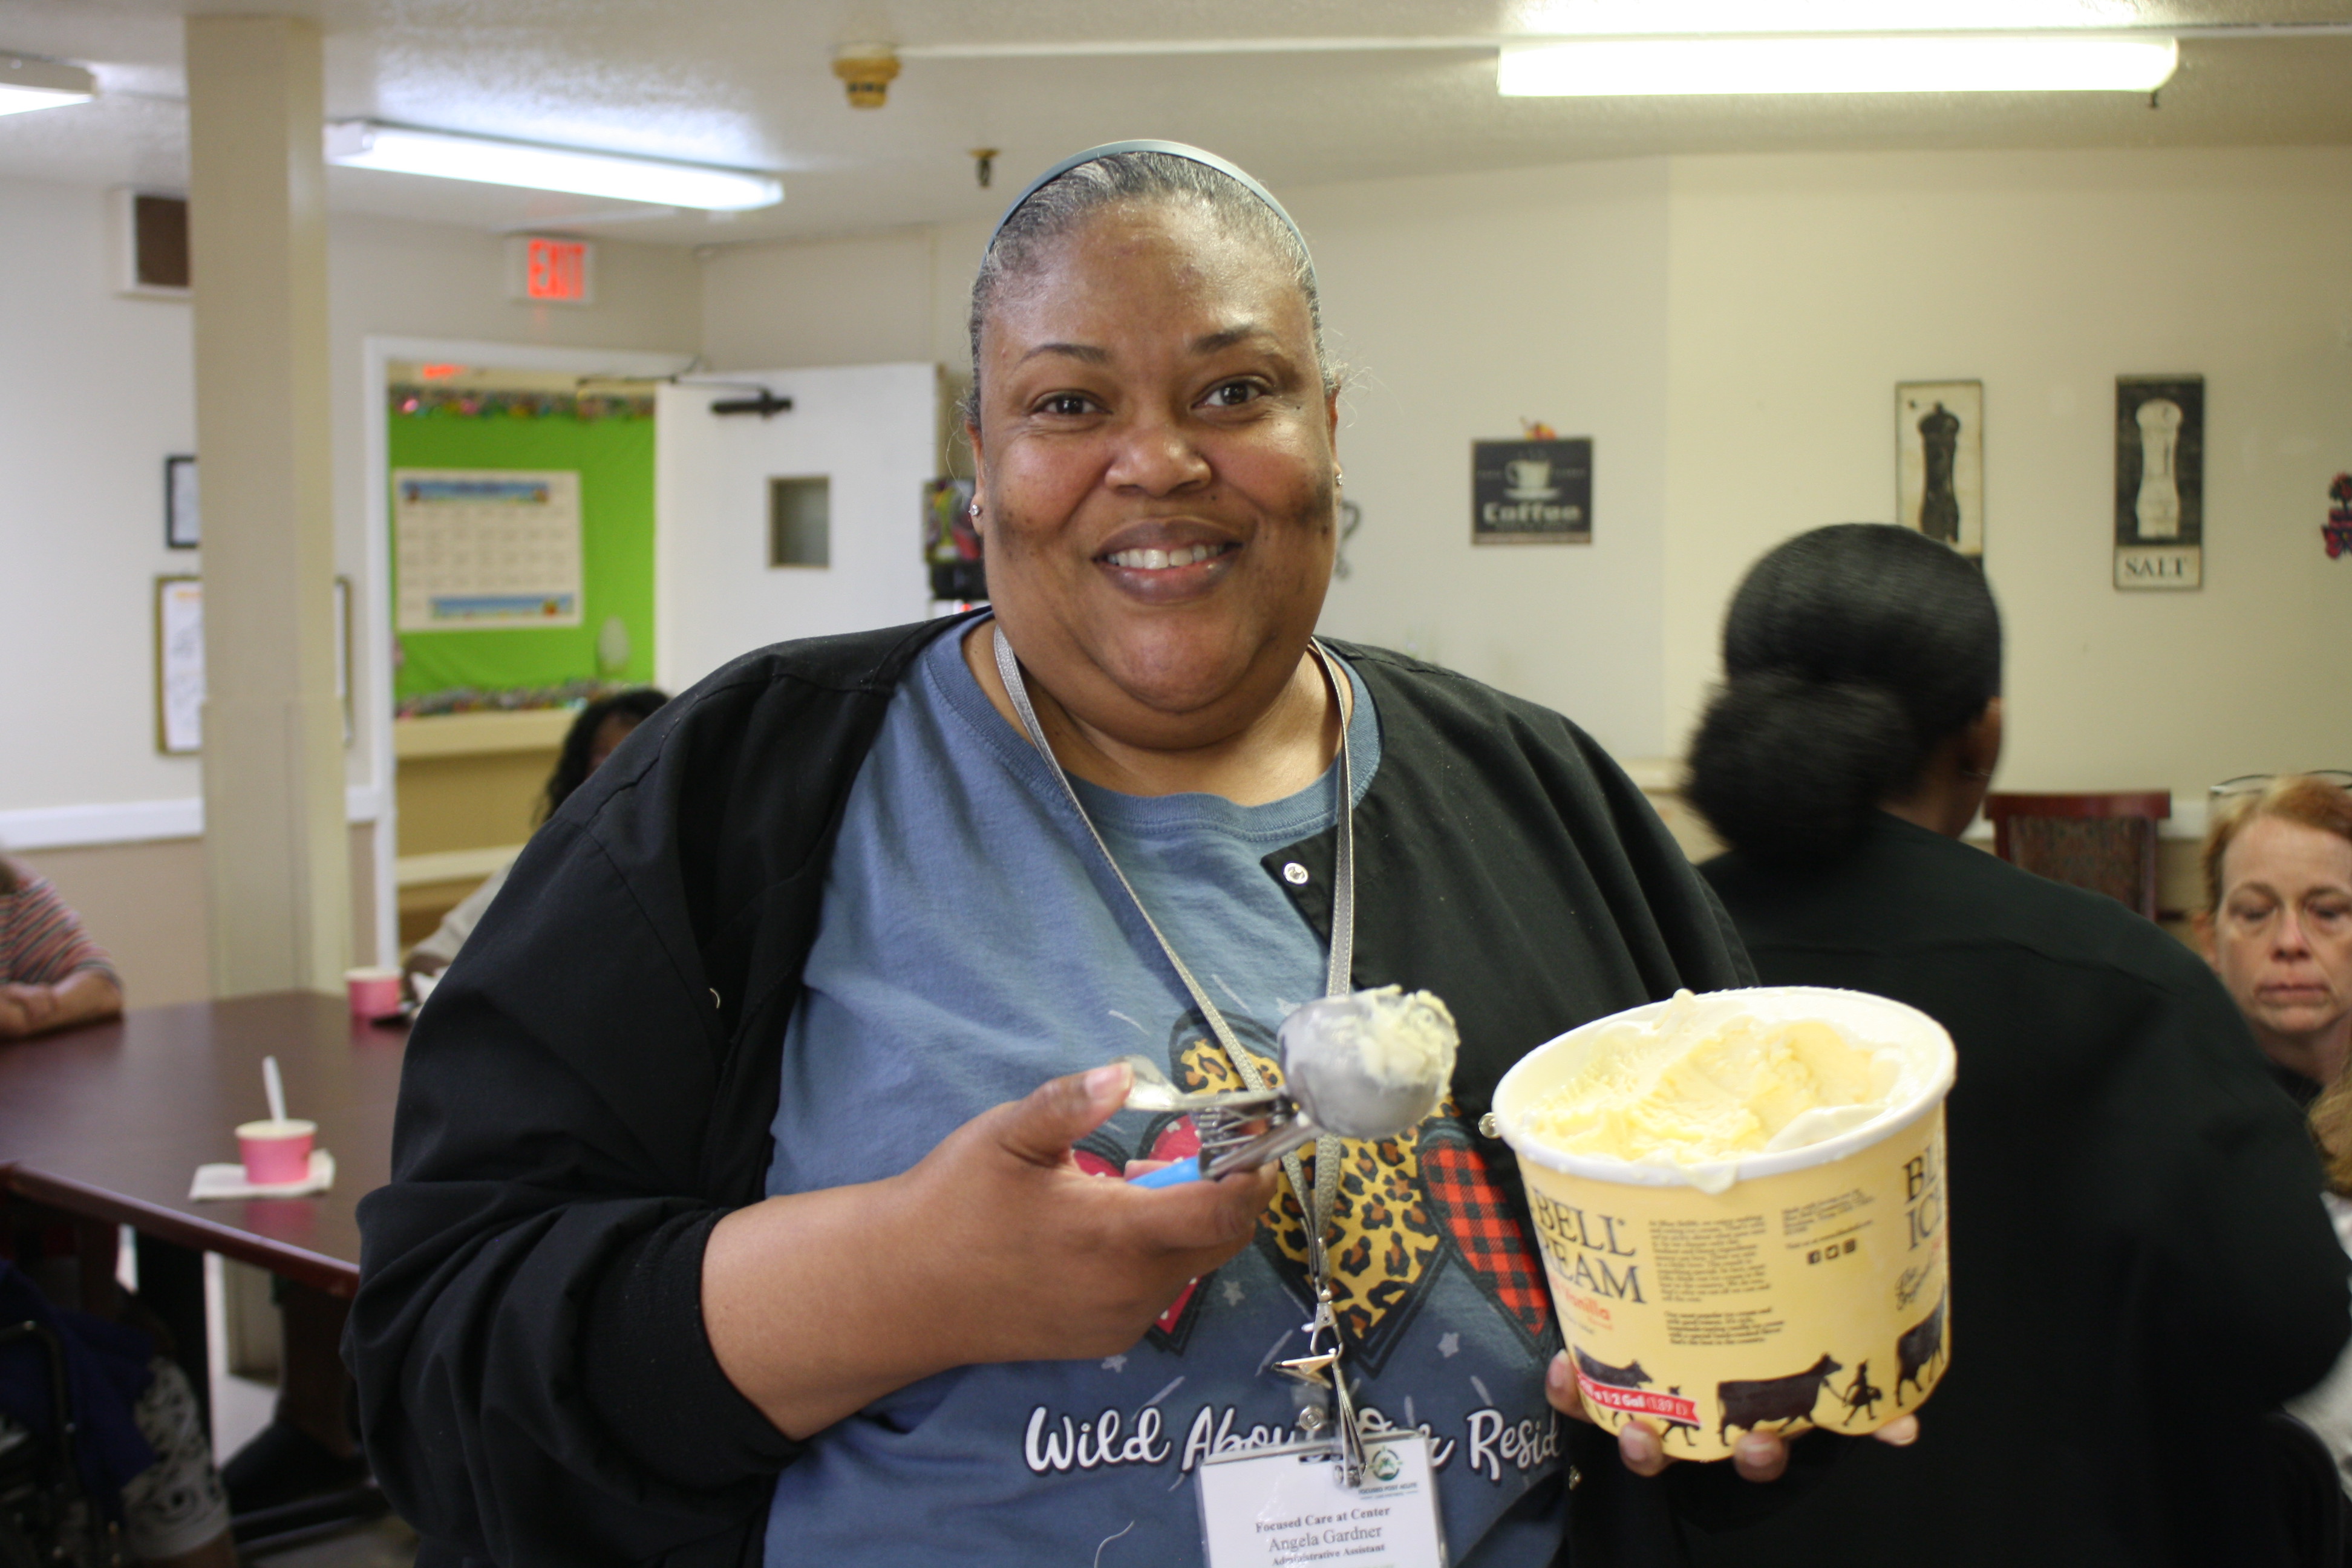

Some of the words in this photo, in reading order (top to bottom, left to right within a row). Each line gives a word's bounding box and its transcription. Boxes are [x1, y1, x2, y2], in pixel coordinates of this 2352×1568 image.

[1483, 501, 1581, 526] Coffee
[2125, 557, 2188, 577] SALT
[1025, 1406, 1171, 1471] Wild
[1181, 1405, 1307, 1471] Abou
[1255, 1517, 1301, 1533] Focused
[1305, 1515, 1332, 1526] Care
[1336, 1512, 1348, 1521] at
[1351, 1508, 1391, 1520] Center
[1269, 1533, 1319, 1552] Angela
[1323, 1526, 1382, 1544] Gardner
[1272, 1550, 1341, 1566] Administrative
[1343, 1544, 1386, 1557] Assistant
